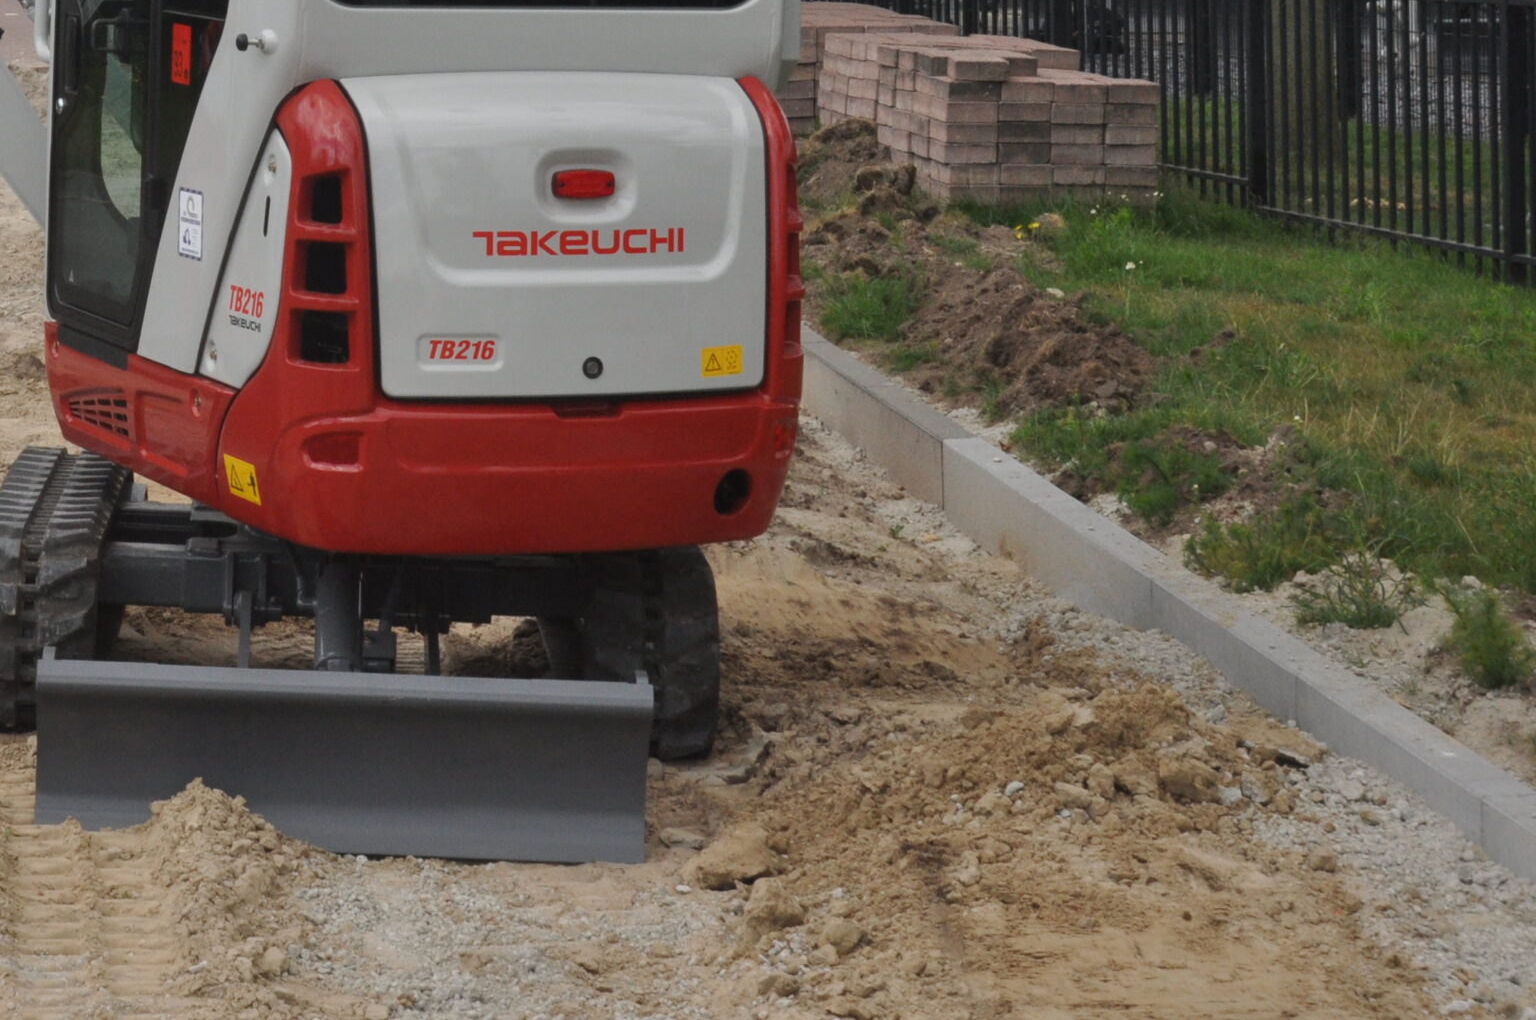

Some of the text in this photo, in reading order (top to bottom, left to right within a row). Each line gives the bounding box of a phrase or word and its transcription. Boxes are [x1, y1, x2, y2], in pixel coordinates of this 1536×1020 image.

[472, 228, 684, 256] TAKEUCHI
[229, 284, 264, 318] TB216
[229, 314, 262, 332] TAKEUCHI
[429, 340, 496, 360] TB216
